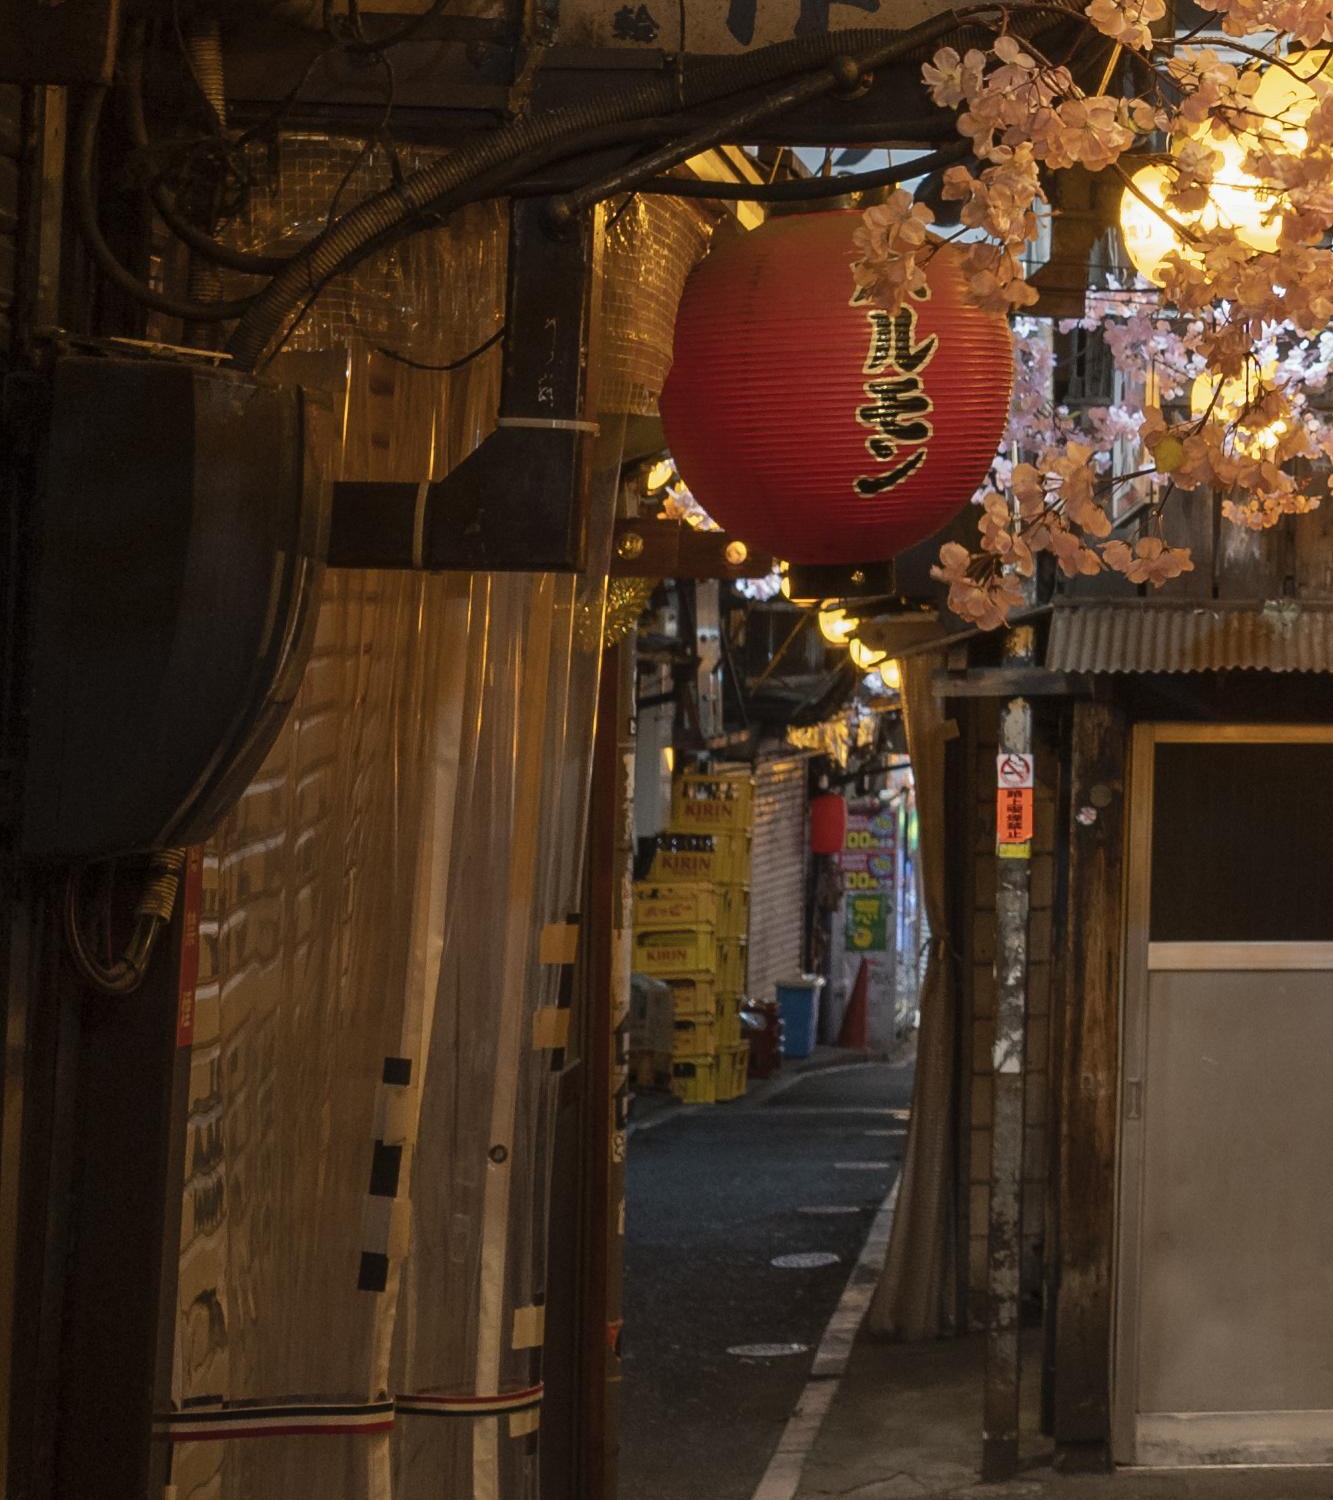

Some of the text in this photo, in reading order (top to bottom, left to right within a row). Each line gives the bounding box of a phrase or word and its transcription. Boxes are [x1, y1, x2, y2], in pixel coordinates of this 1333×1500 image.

[848, 285, 940, 498] ルモン
[683, 802, 734, 819] KIRIN
[661, 855, 712, 874] KIRIN
[645, 947, 688, 963] KIRIN
